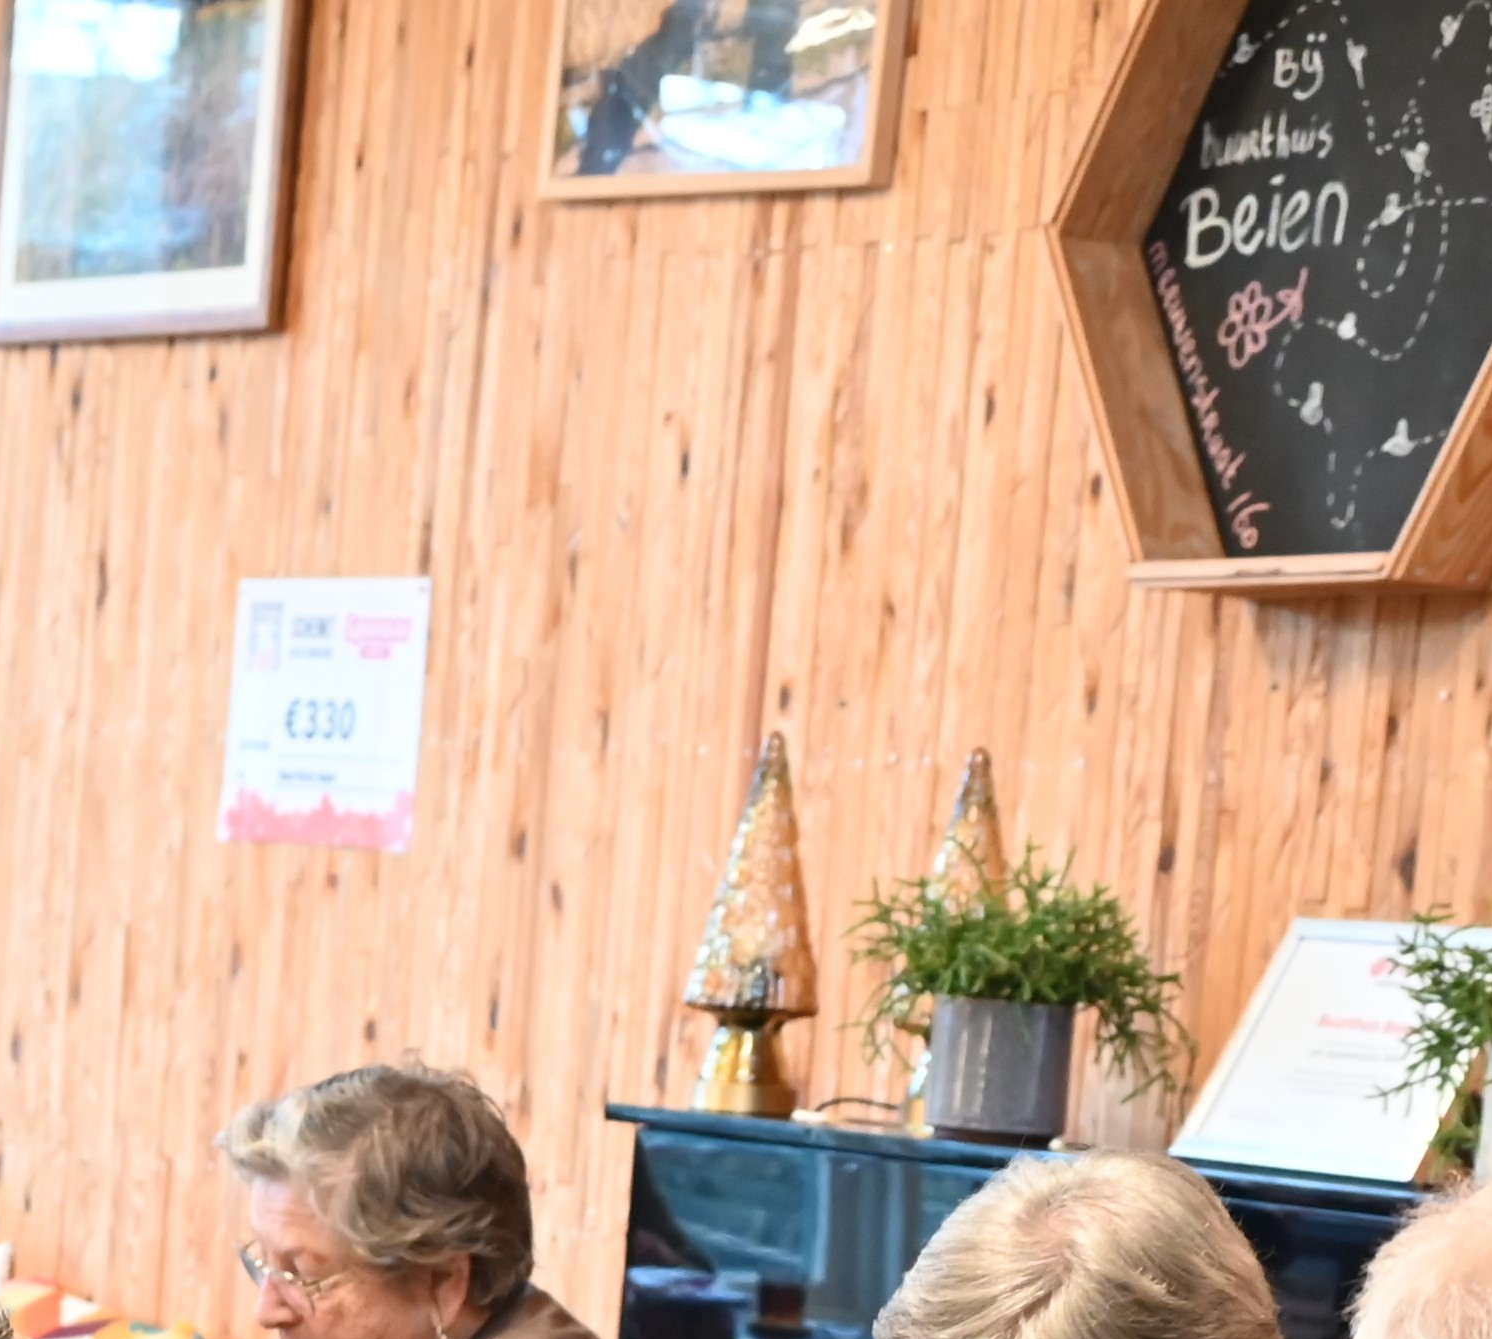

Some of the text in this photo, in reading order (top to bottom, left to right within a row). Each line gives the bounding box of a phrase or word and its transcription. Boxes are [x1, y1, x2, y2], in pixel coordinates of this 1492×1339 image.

[1178, 171, 1350, 269] Beien
[1226, 489, 1271, 551] 160
[286, 697, 355, 740] €330
